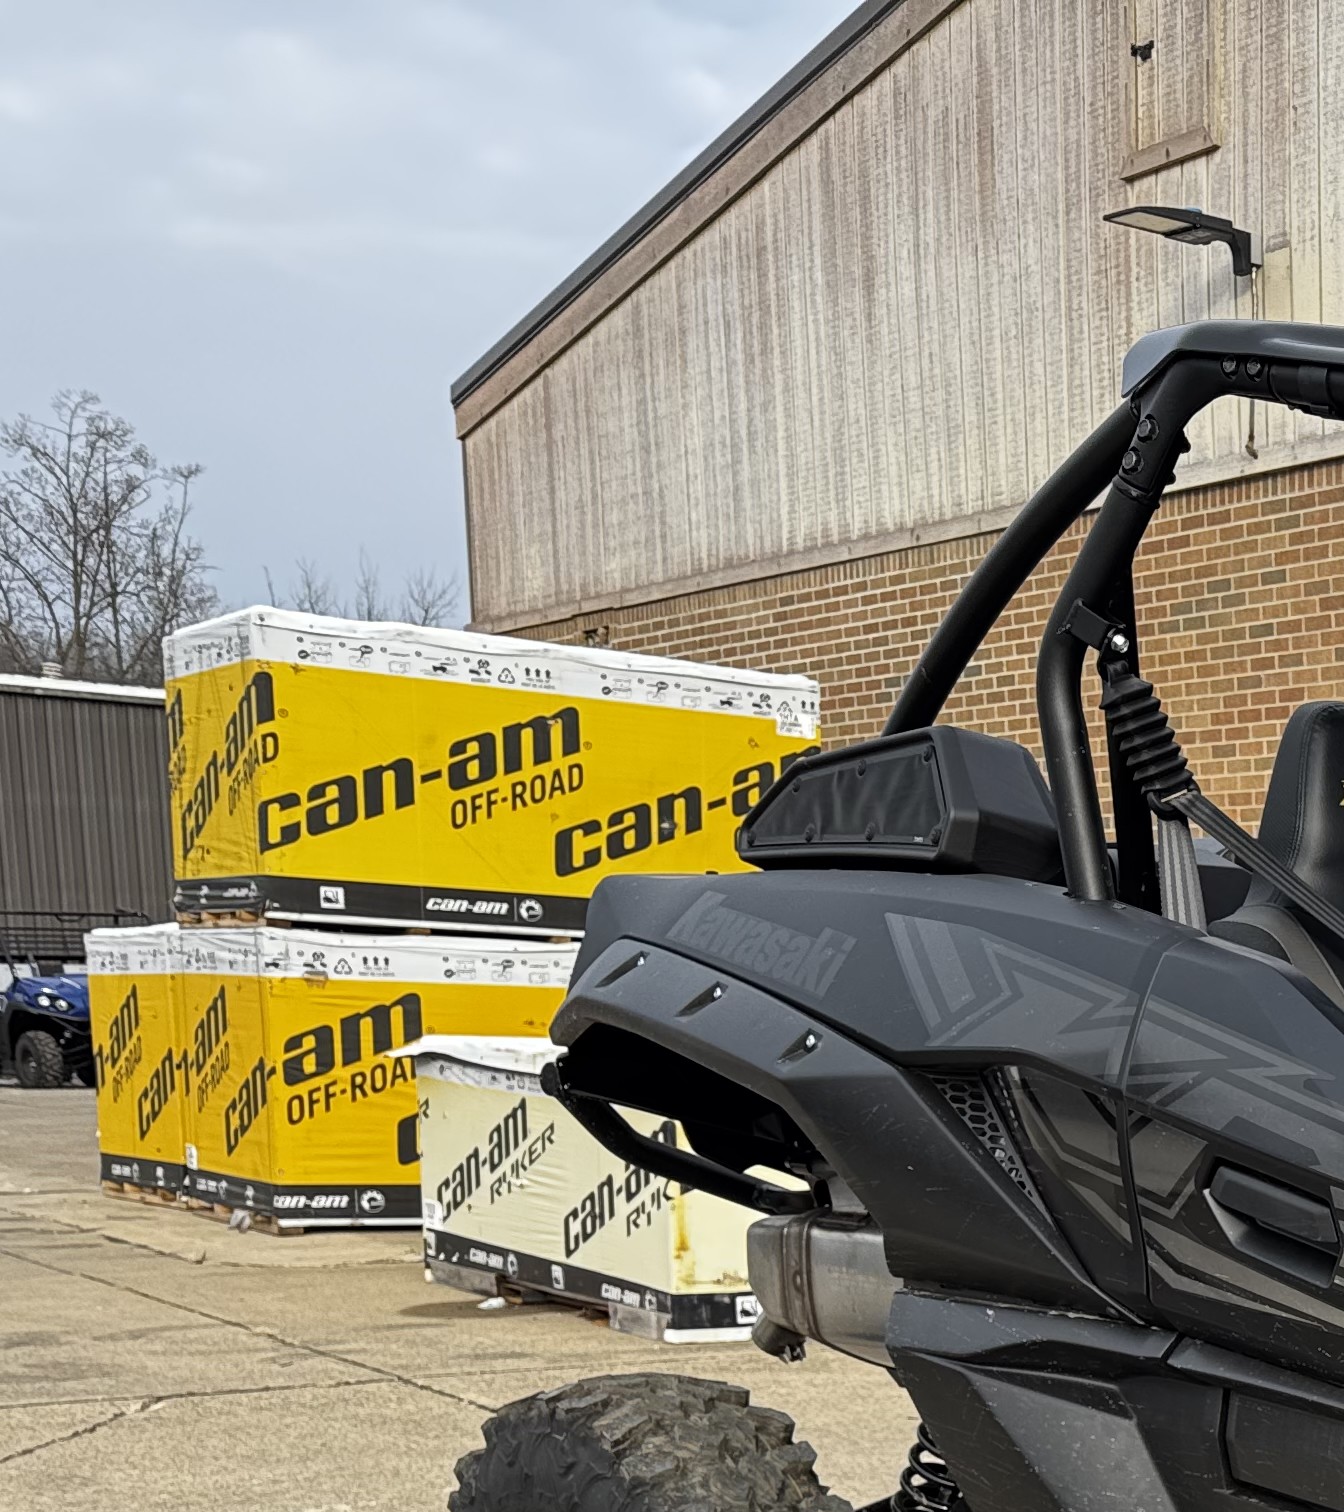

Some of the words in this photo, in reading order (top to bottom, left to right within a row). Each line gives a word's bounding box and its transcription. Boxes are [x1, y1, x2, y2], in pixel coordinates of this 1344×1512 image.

[181, 671, 275, 861] can-am
[258, 706, 580, 854] can-am
[451, 762, 584, 830] OFF-ROAD
[554, 744, 821, 877] can-a
[426, 897, 508, 916] can-am
[665, 890, 858, 998] Kawasaki
[437, 1096, 528, 1225] can-am
[490, 1121, 555, 1204] RYKER
